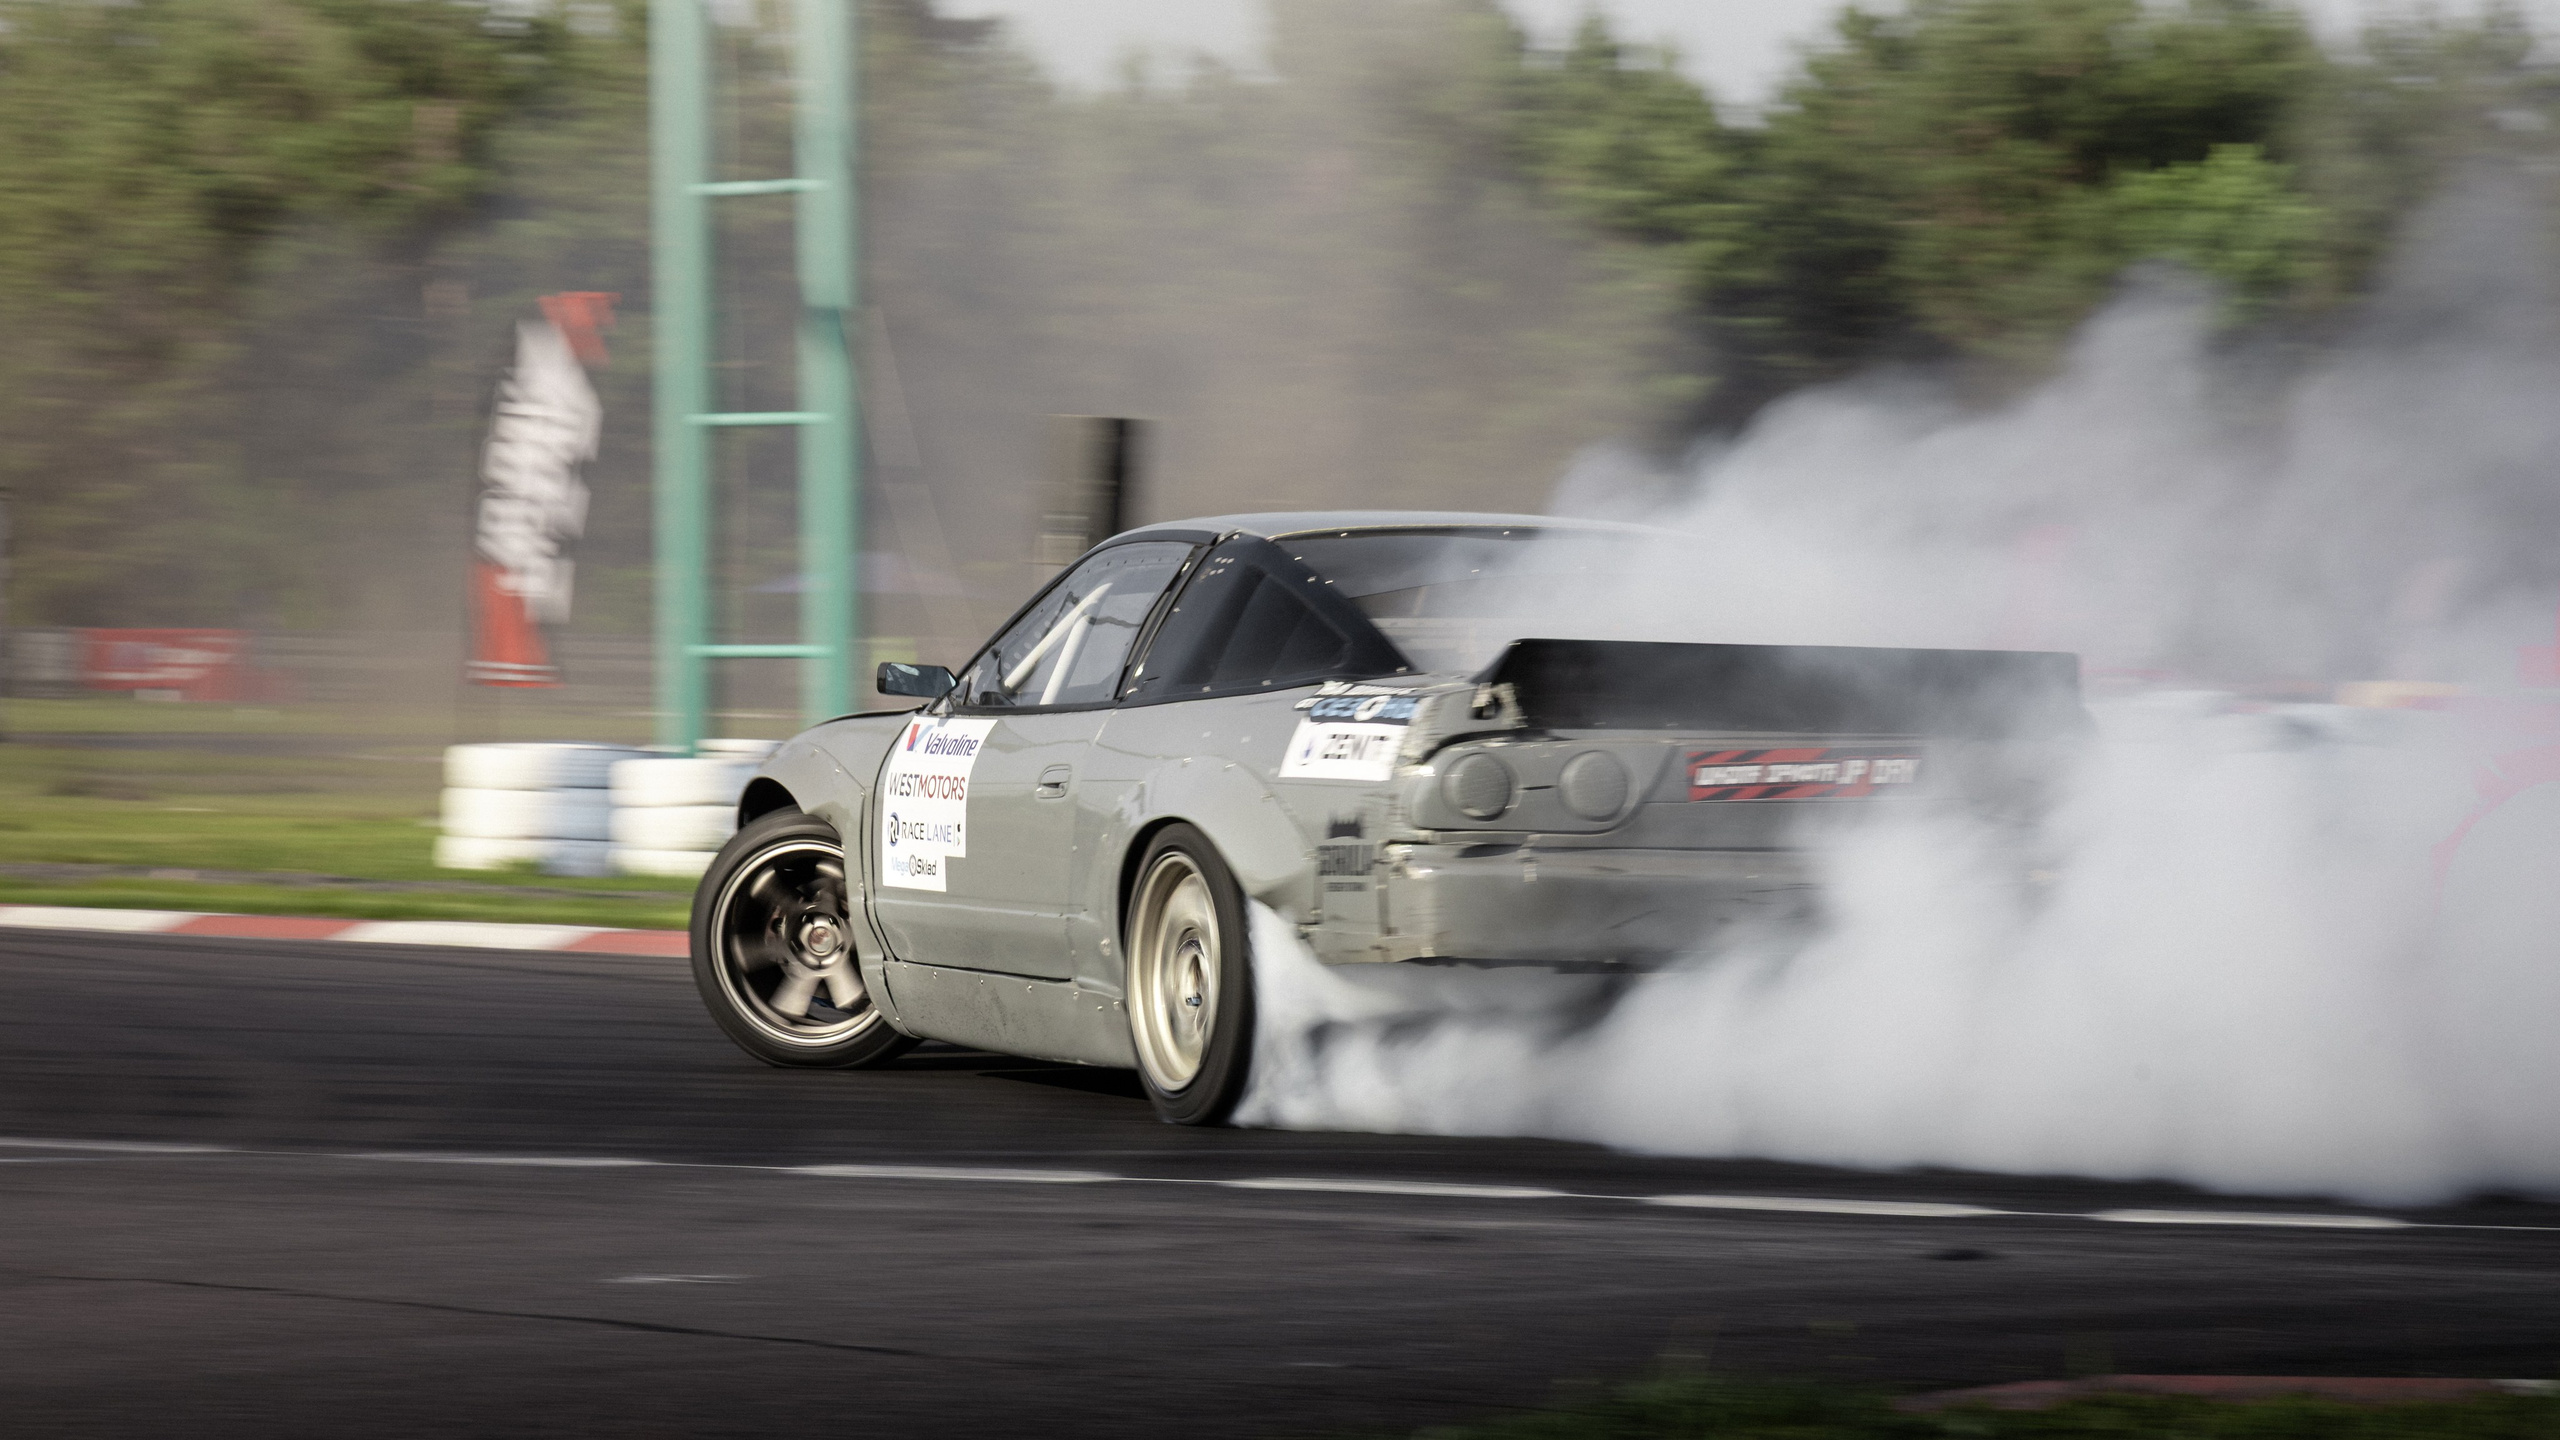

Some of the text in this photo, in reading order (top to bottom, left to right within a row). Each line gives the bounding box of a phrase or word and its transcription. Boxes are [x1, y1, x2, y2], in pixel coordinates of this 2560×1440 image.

[924, 733, 979, 757] Valvoline
[889, 772, 966, 801] WESTMOTORS
[902, 822, 952, 843] RACE LANE
